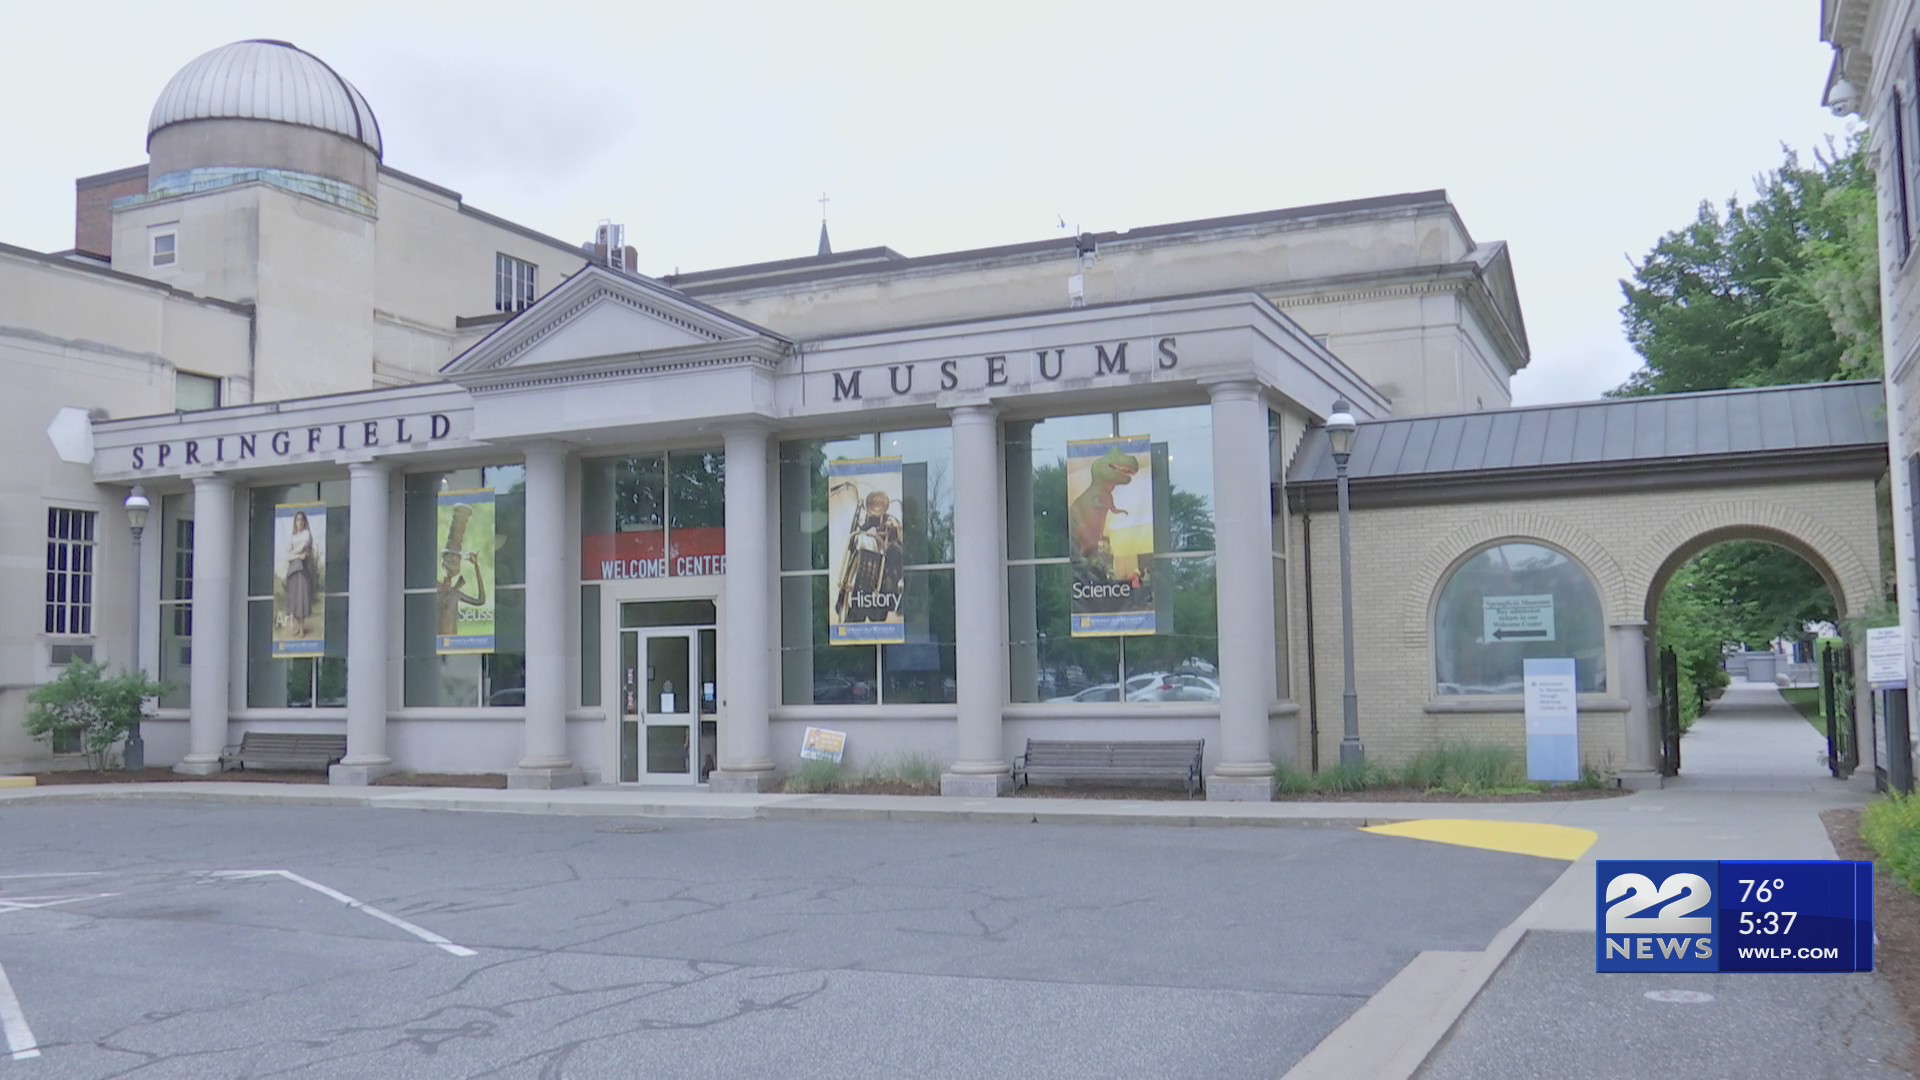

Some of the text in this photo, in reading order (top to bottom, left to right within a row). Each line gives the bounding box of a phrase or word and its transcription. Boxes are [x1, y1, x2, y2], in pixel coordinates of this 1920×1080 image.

[833, 337, 1179, 402] MUSEUMS
[132, 413, 451, 470] SPRINGFIELD
[601, 559, 665, 579] WELCOME
[1072, 581, 1131, 599] Science
[848, 590, 903, 611] History
[275, 611, 294, 628] Art
[457, 608, 493, 622] Seuss
